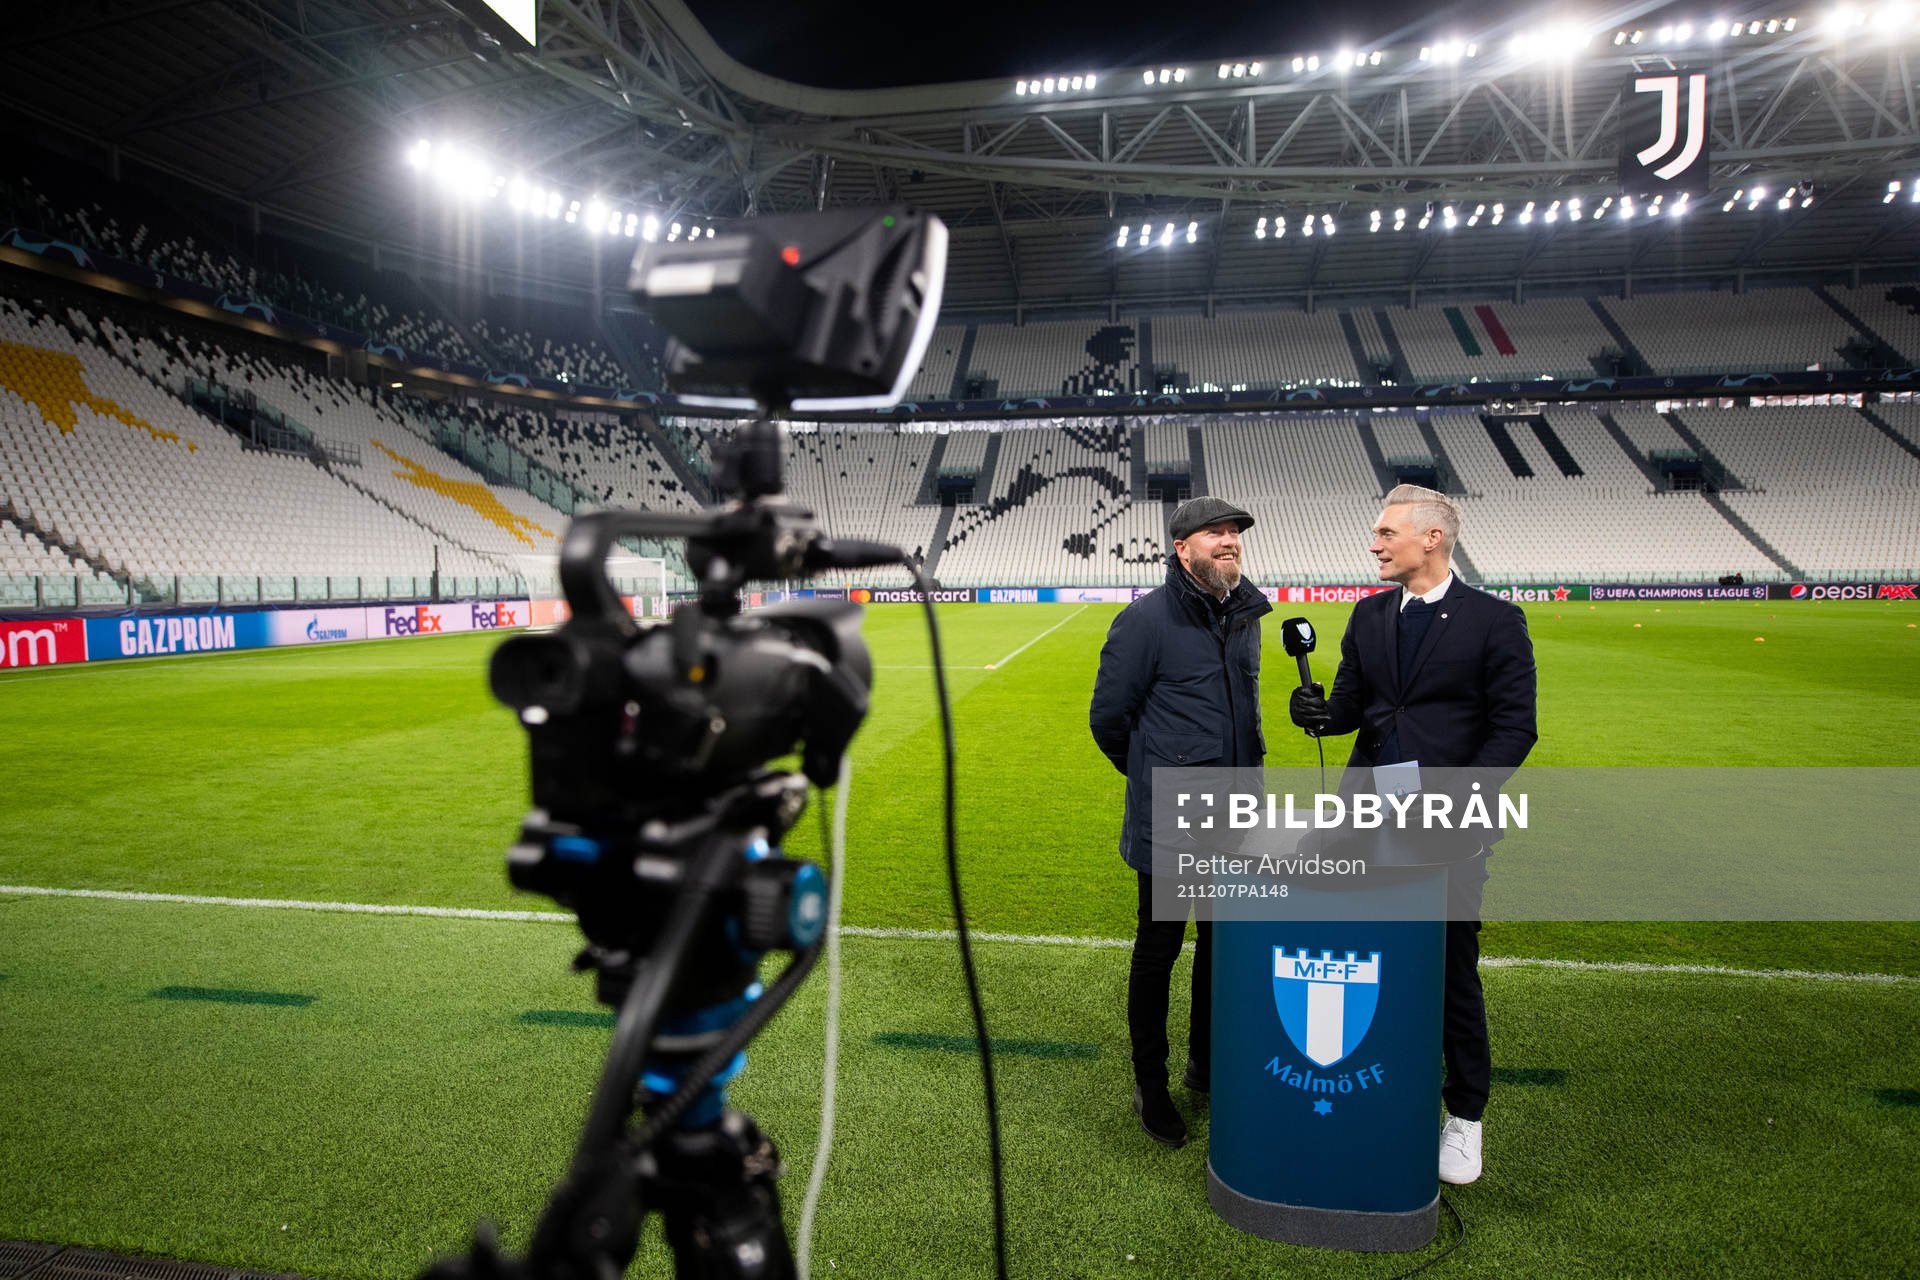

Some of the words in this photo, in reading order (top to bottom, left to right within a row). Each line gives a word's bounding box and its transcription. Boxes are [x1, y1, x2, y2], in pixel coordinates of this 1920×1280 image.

[874, 589, 970, 602] mastercard
[990, 589, 1038, 603] GAZPROM
[1311, 587, 1385, 602] Hotels
[1606, 588, 1636, 598] UEFA
[1638, 588, 1704, 598] CHAMPIONS
[1707, 588, 1750, 598] LEAGUE
[1812, 584, 1873, 600] pepsi
[1877, 584, 1918, 600] MAX
[385, 606, 442, 635] FedEx
[471, 603, 516, 628] FedEx
[120, 615, 236, 656] GAZPROM
[1264, 1056, 1353, 1094] Malmö
[1355, 1063, 1385, 1090] FF
